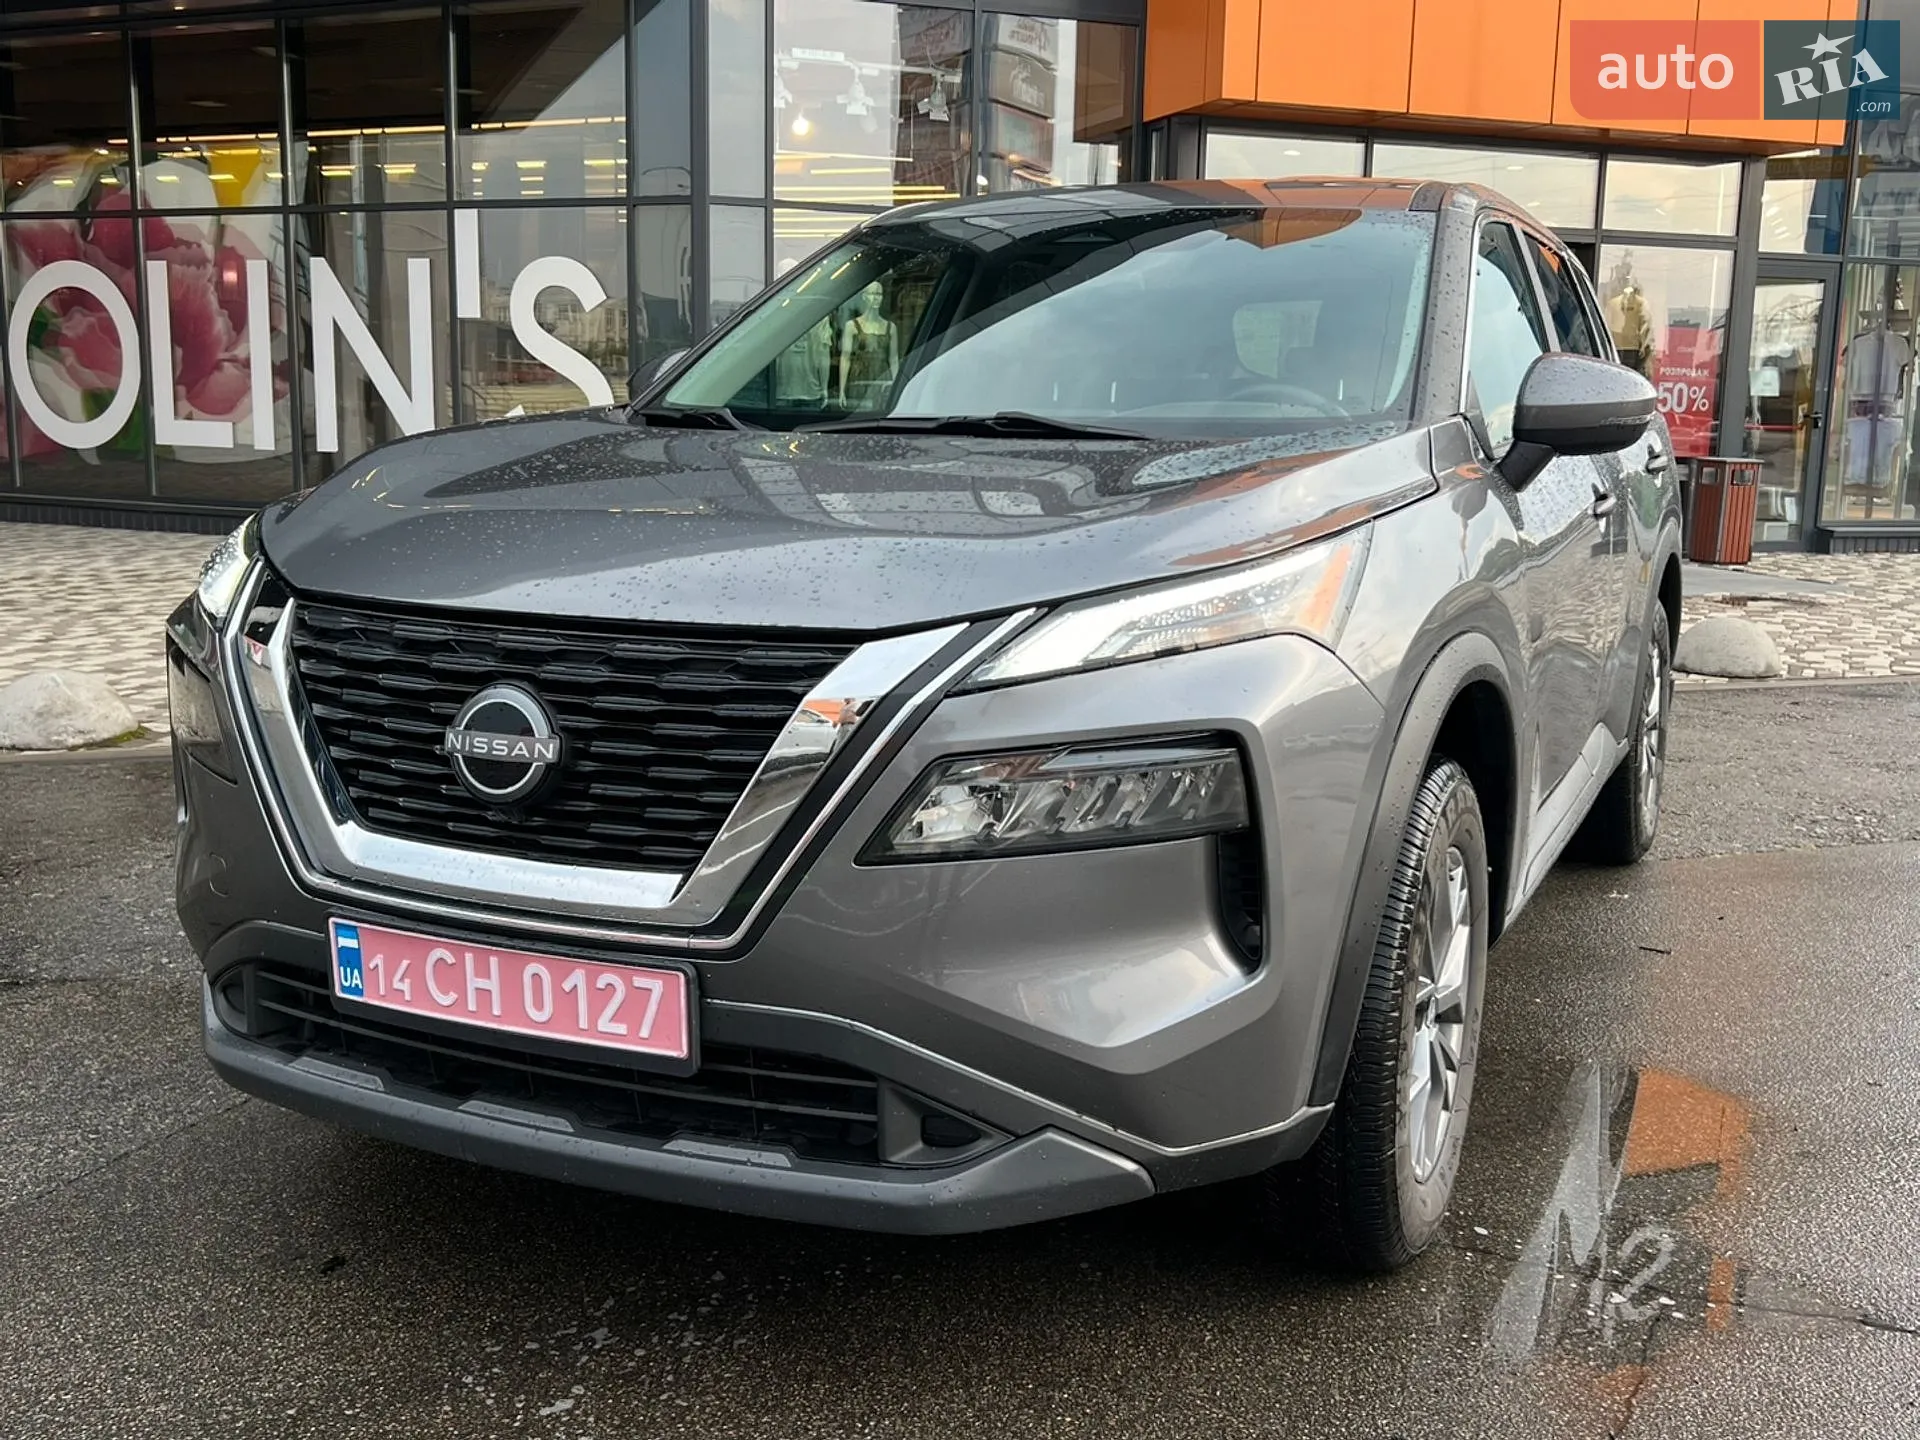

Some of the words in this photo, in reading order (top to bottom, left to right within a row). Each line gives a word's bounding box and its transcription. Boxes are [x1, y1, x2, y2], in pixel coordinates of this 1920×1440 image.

[1659, 367, 1710, 377] РОЗПРОДАЖ
[1656, 381, 1709, 413] 50%
[447, 732, 555, 760] NISSAN
[339, 966, 363, 989] UA
[368, 953, 413, 1001] 14
[424, 947, 502, 1017] CH
[522, 962, 664, 1039] 0127
